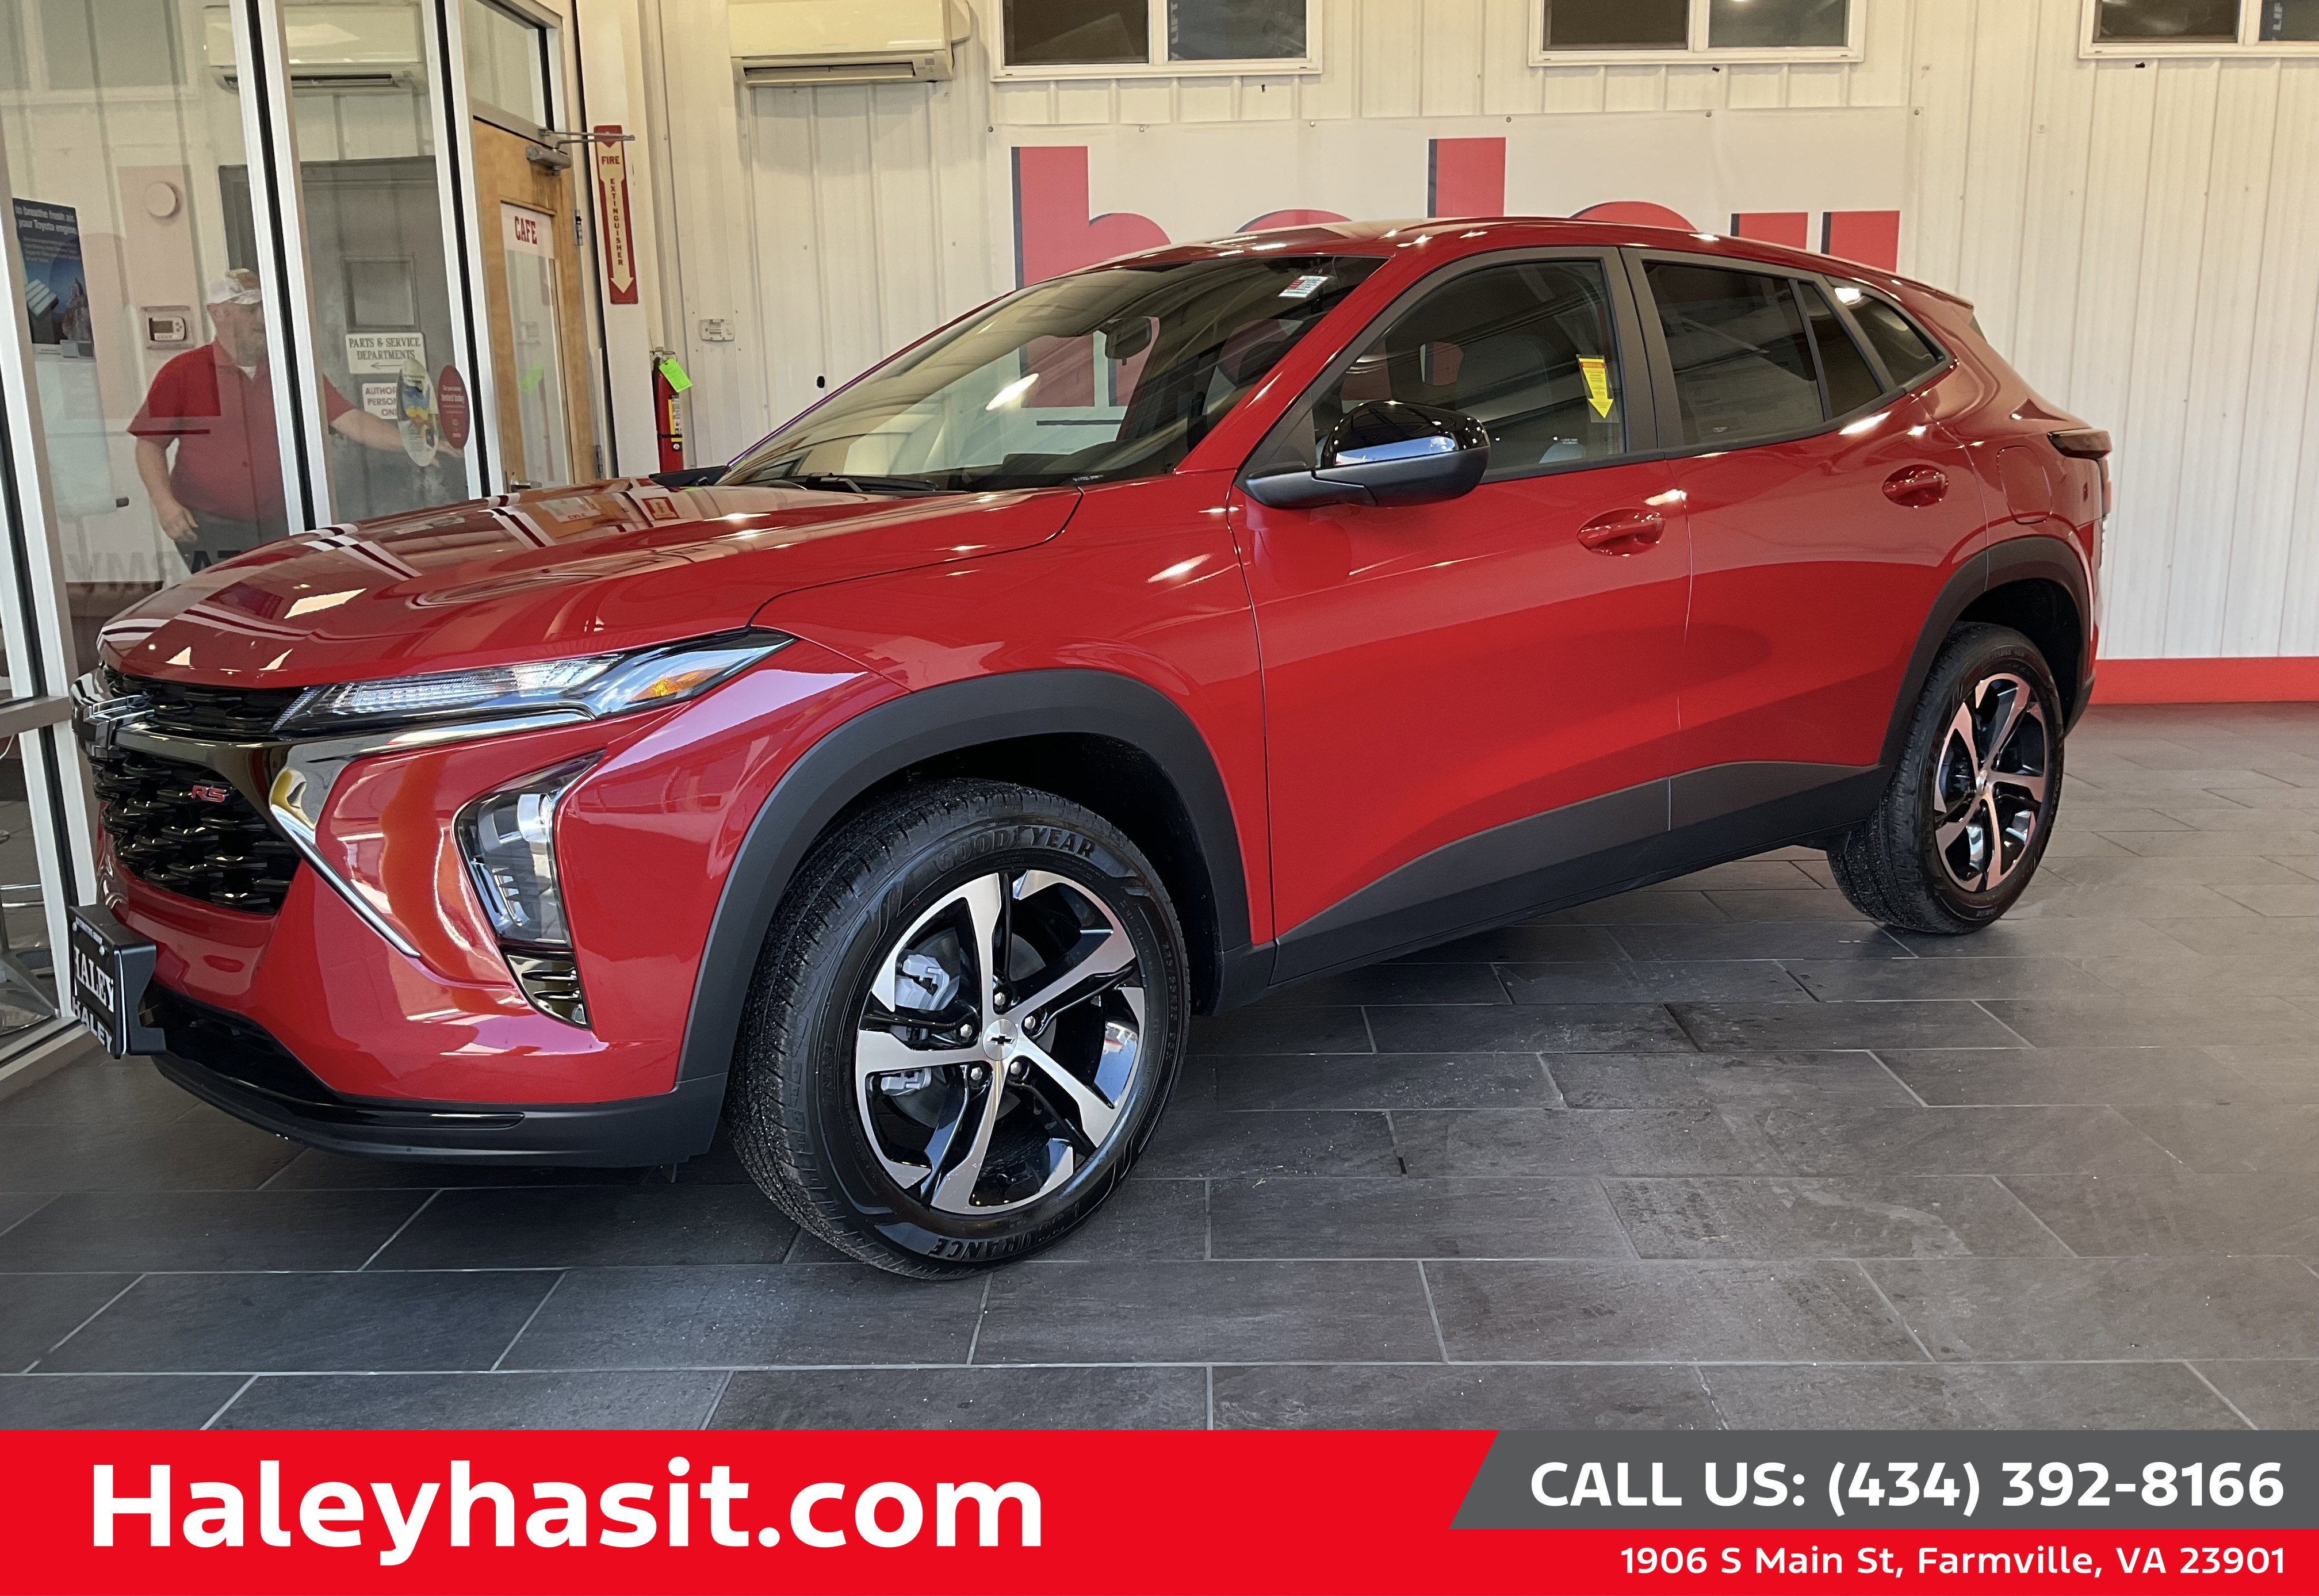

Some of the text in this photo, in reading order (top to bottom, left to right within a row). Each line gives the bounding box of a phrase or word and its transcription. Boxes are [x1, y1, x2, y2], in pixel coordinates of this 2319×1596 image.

[601, 155, 620, 165] FIRE
[514, 216, 537, 245] CAFE
[610, 178, 623, 266] EXTINGUISHER
[349, 337, 421, 348] PARTS & SERVICE
[357, 350, 415, 360] DEPARTMENTS
[190, 784, 227, 803] RS
[935, 826, 1096, 872] GOODYEAR
[72, 994, 113, 1054] HALEY
